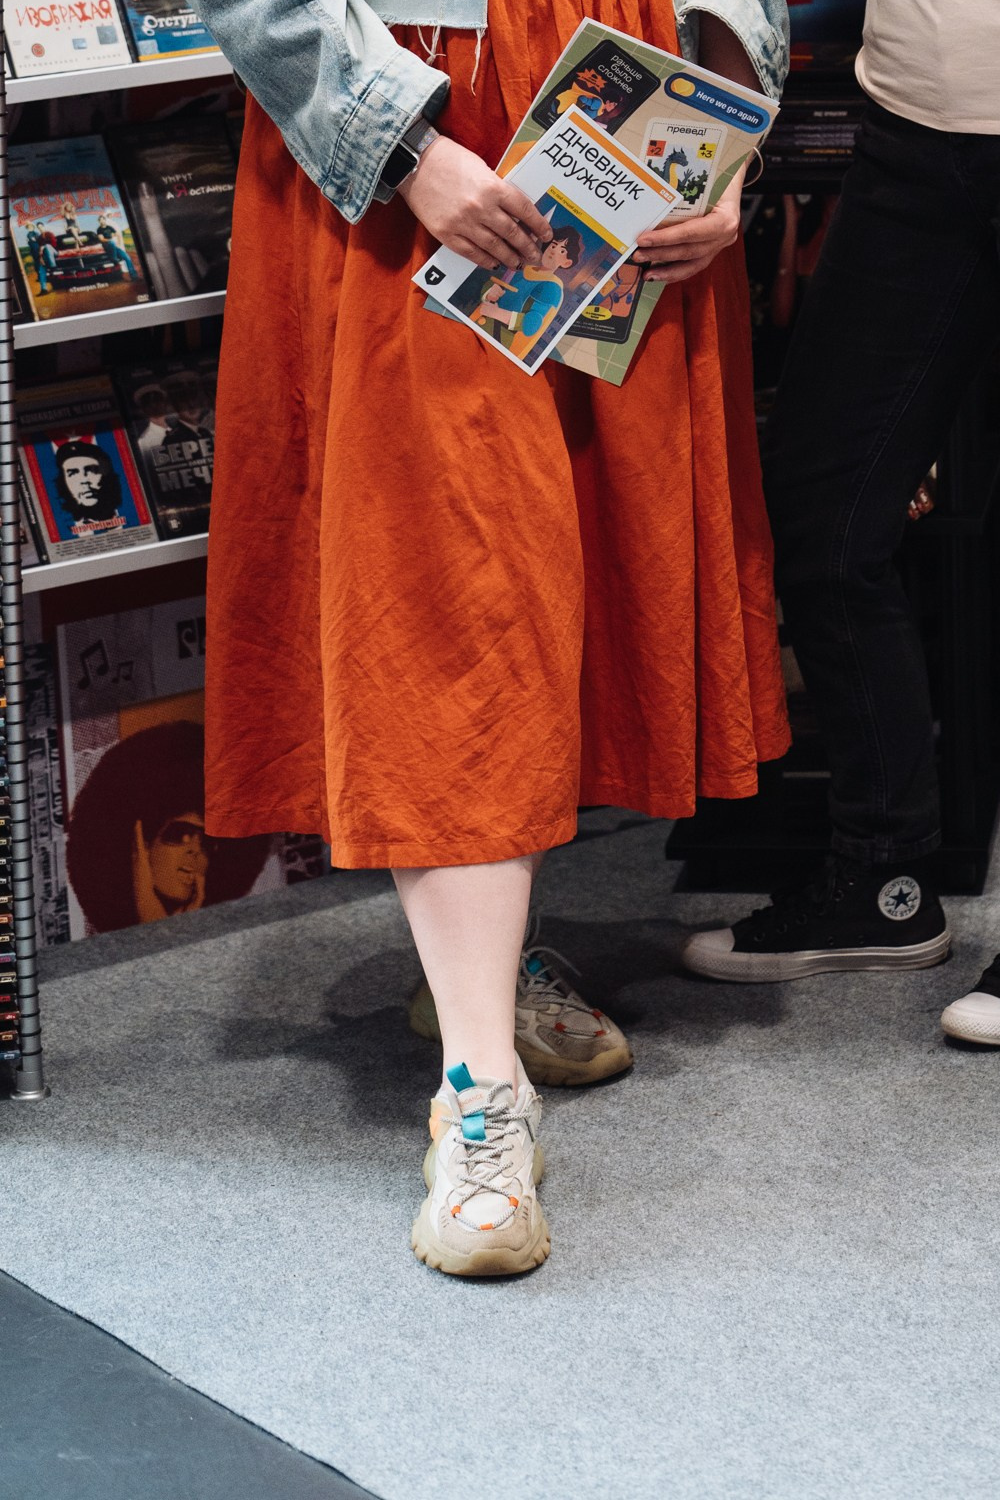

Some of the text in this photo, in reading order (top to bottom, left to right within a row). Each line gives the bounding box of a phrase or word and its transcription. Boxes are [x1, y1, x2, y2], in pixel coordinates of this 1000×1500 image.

[597, 64, 633, 94] сложнее
[610, 54, 643, 81] раньше
[610, 62, 633, 83] было
[696, 90, 760, 126] Here we go again
[666, 125, 708, 137] превед!
[158, 463, 213, 492] МЕЧ
